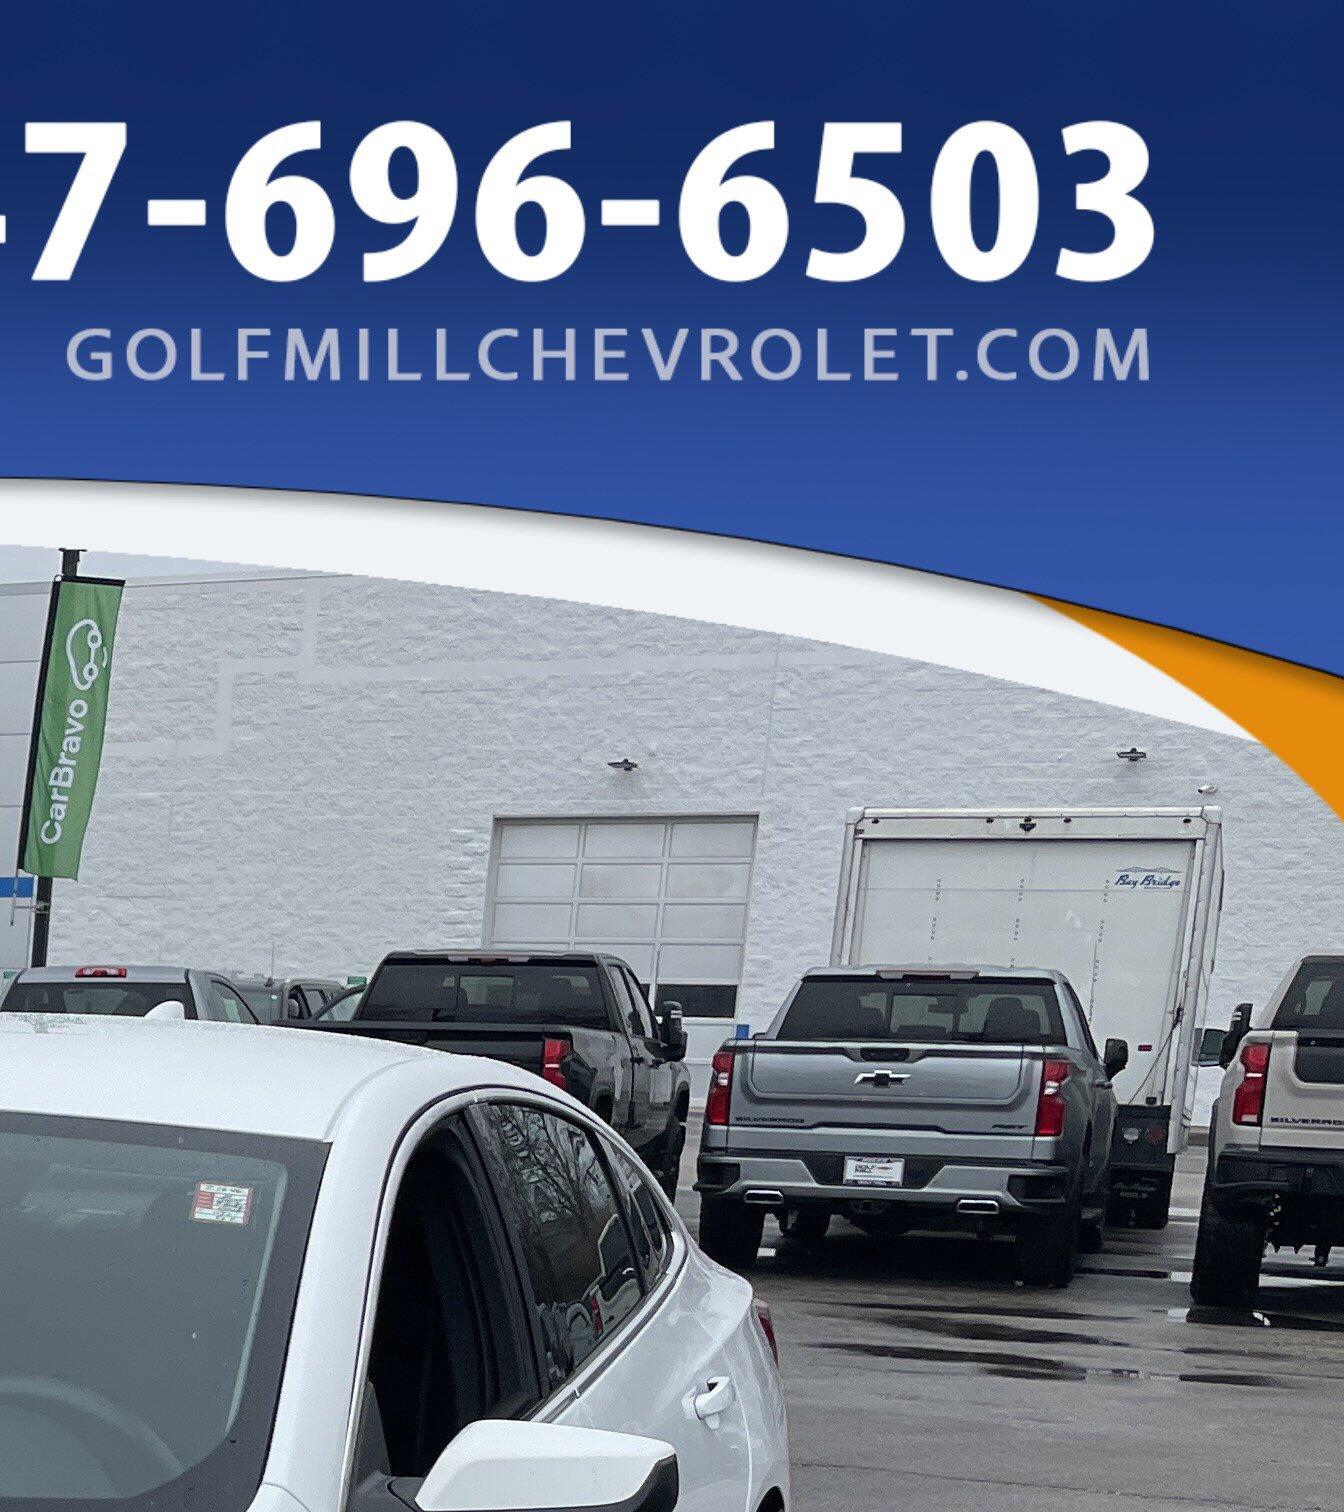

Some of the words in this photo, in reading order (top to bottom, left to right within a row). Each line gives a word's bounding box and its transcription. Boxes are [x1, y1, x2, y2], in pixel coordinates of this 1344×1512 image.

[40, 699, 89, 845] CarBravo
[1140, 874, 1181, 890] Bridge
[1270, 1117, 1344, 1126] SILVERAD
